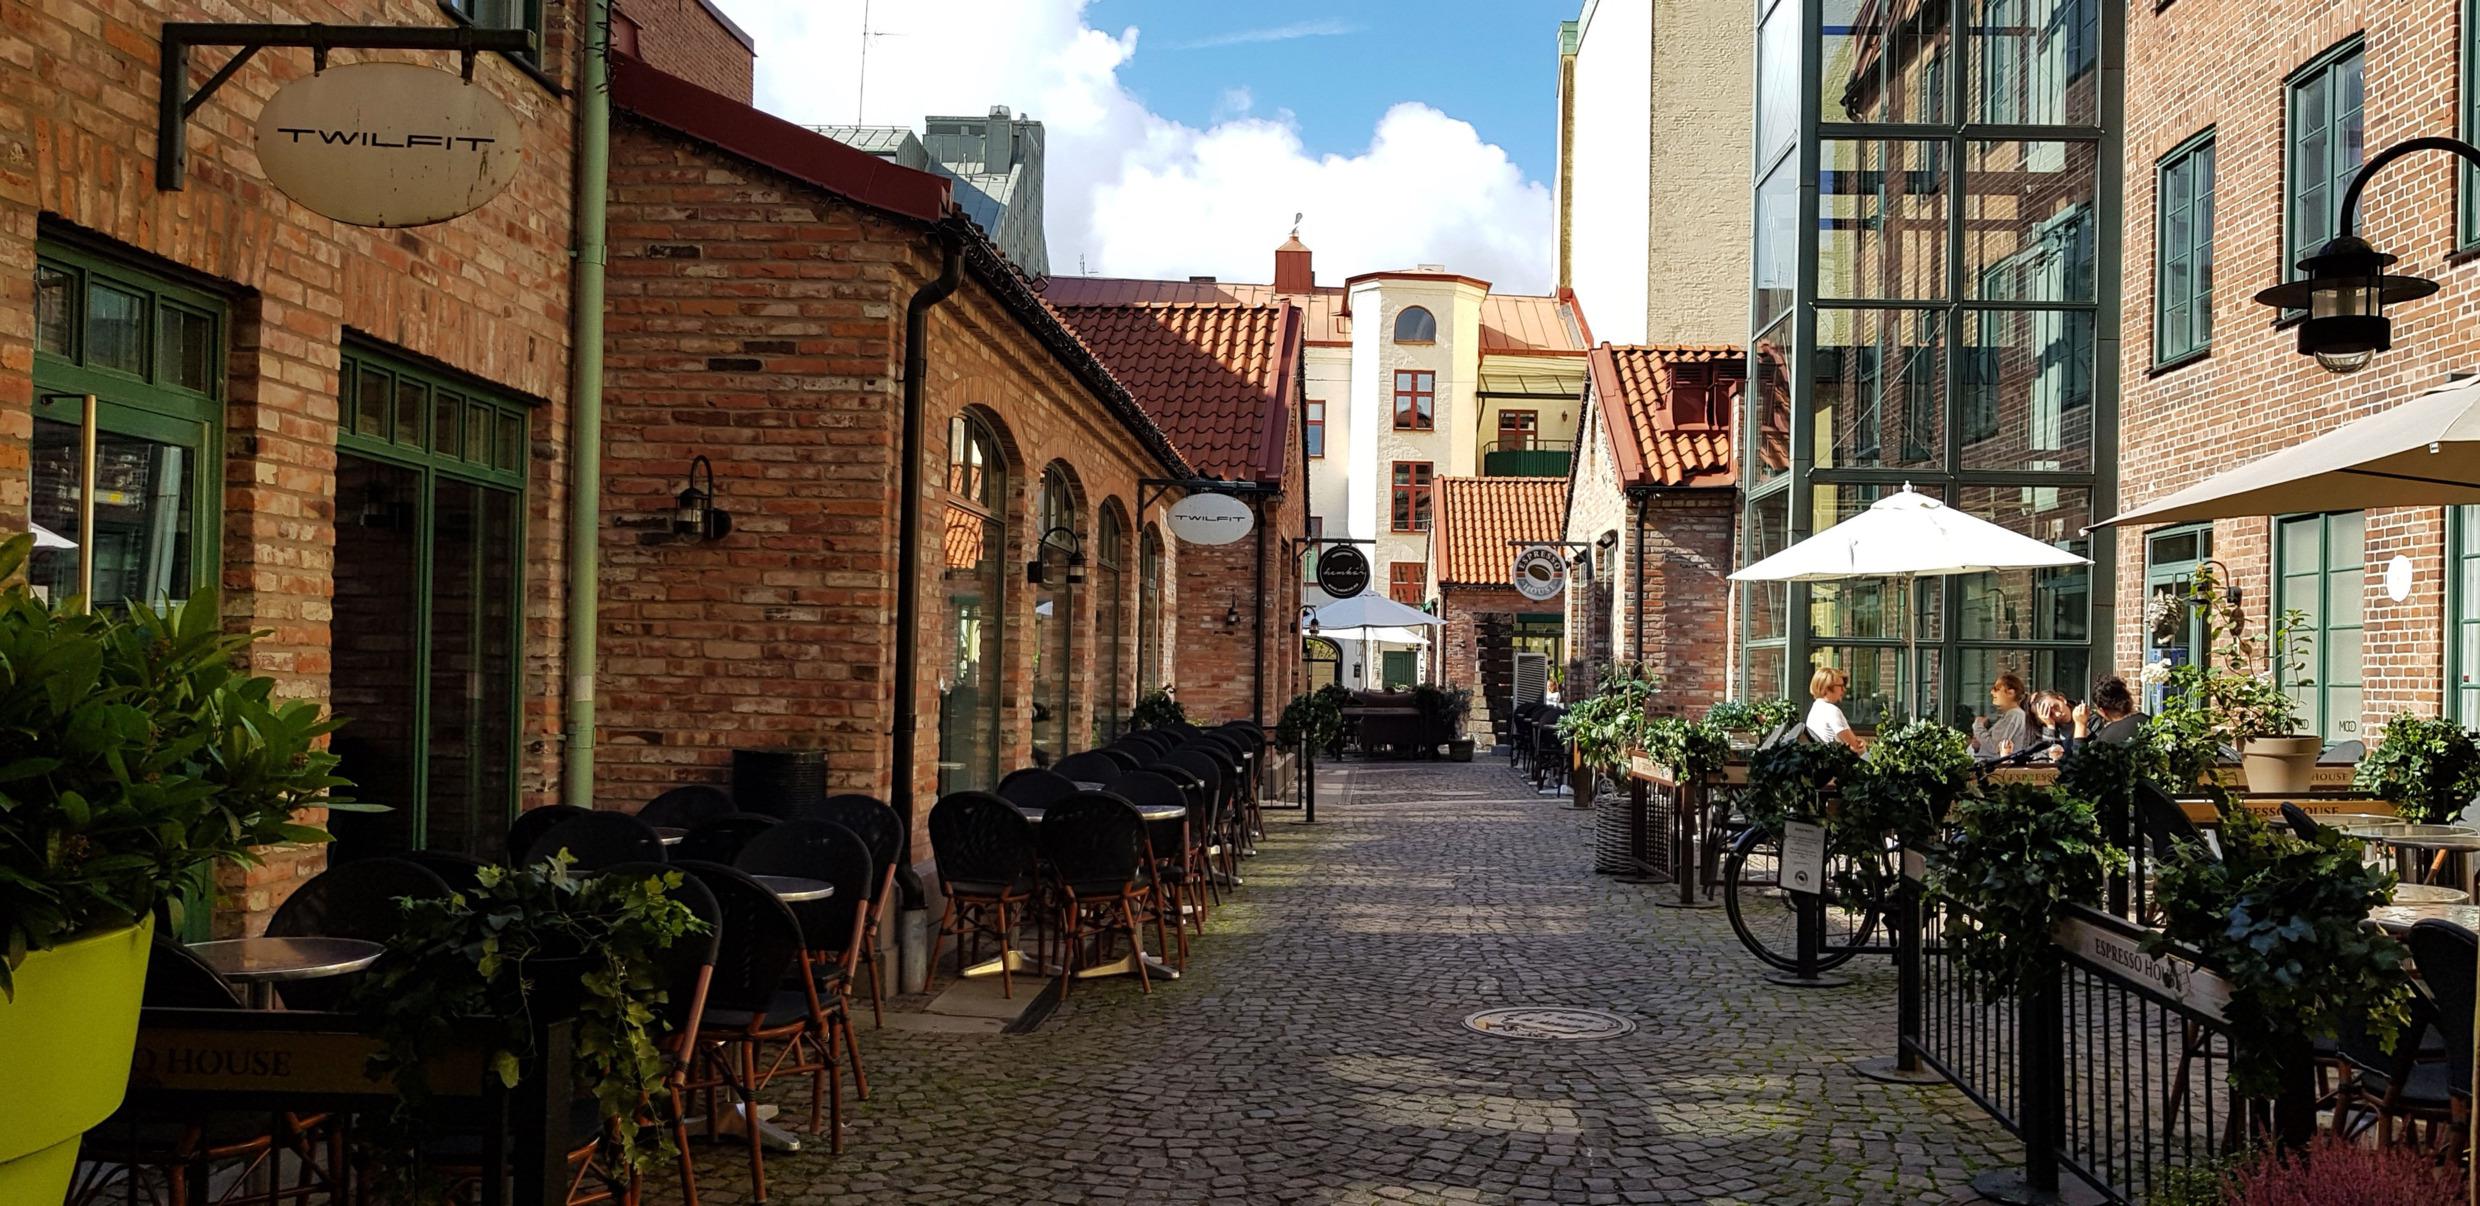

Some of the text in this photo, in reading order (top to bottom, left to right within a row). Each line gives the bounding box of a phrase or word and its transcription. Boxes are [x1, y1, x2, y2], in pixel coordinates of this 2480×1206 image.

[277, 128, 496, 152] TWILFIT
[1175, 514, 1246, 523] TWILFIT
[1518, 550, 1561, 569] ESPRESSO
[1523, 583, 1555, 595] HOUSE
[2311, 772, 2348, 782] HOUSE
[2246, 806, 2340, 817] RESS OUSE
[2095, 938, 2142, 972] ESPRESSO
[167, 1047, 292, 1077] HOUSE
